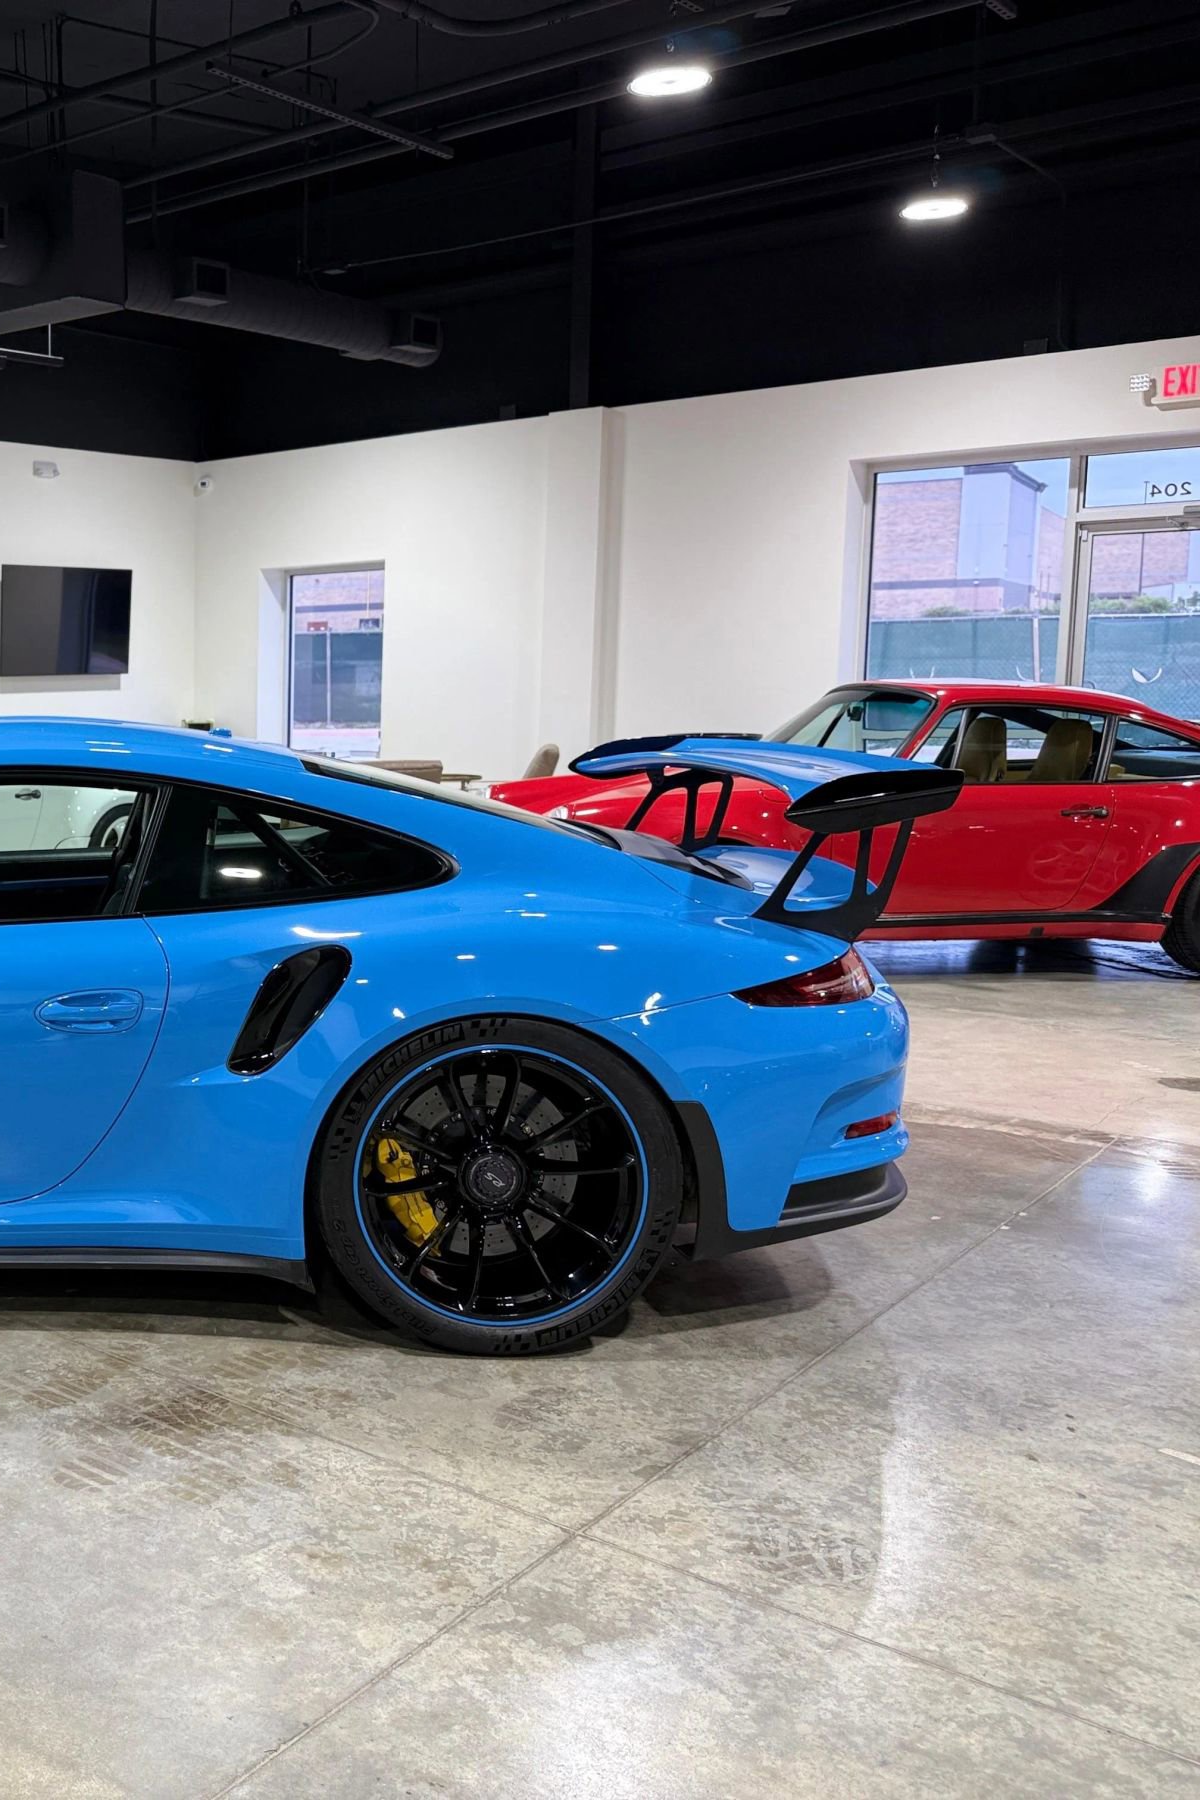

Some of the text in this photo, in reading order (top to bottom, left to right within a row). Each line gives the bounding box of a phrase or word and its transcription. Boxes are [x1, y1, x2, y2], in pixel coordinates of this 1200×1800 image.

[1163, 365, 1200, 397] EXI
[360, 1023, 464, 1099] MICHELIN
[536, 1272, 641, 1346] MICHELIN
